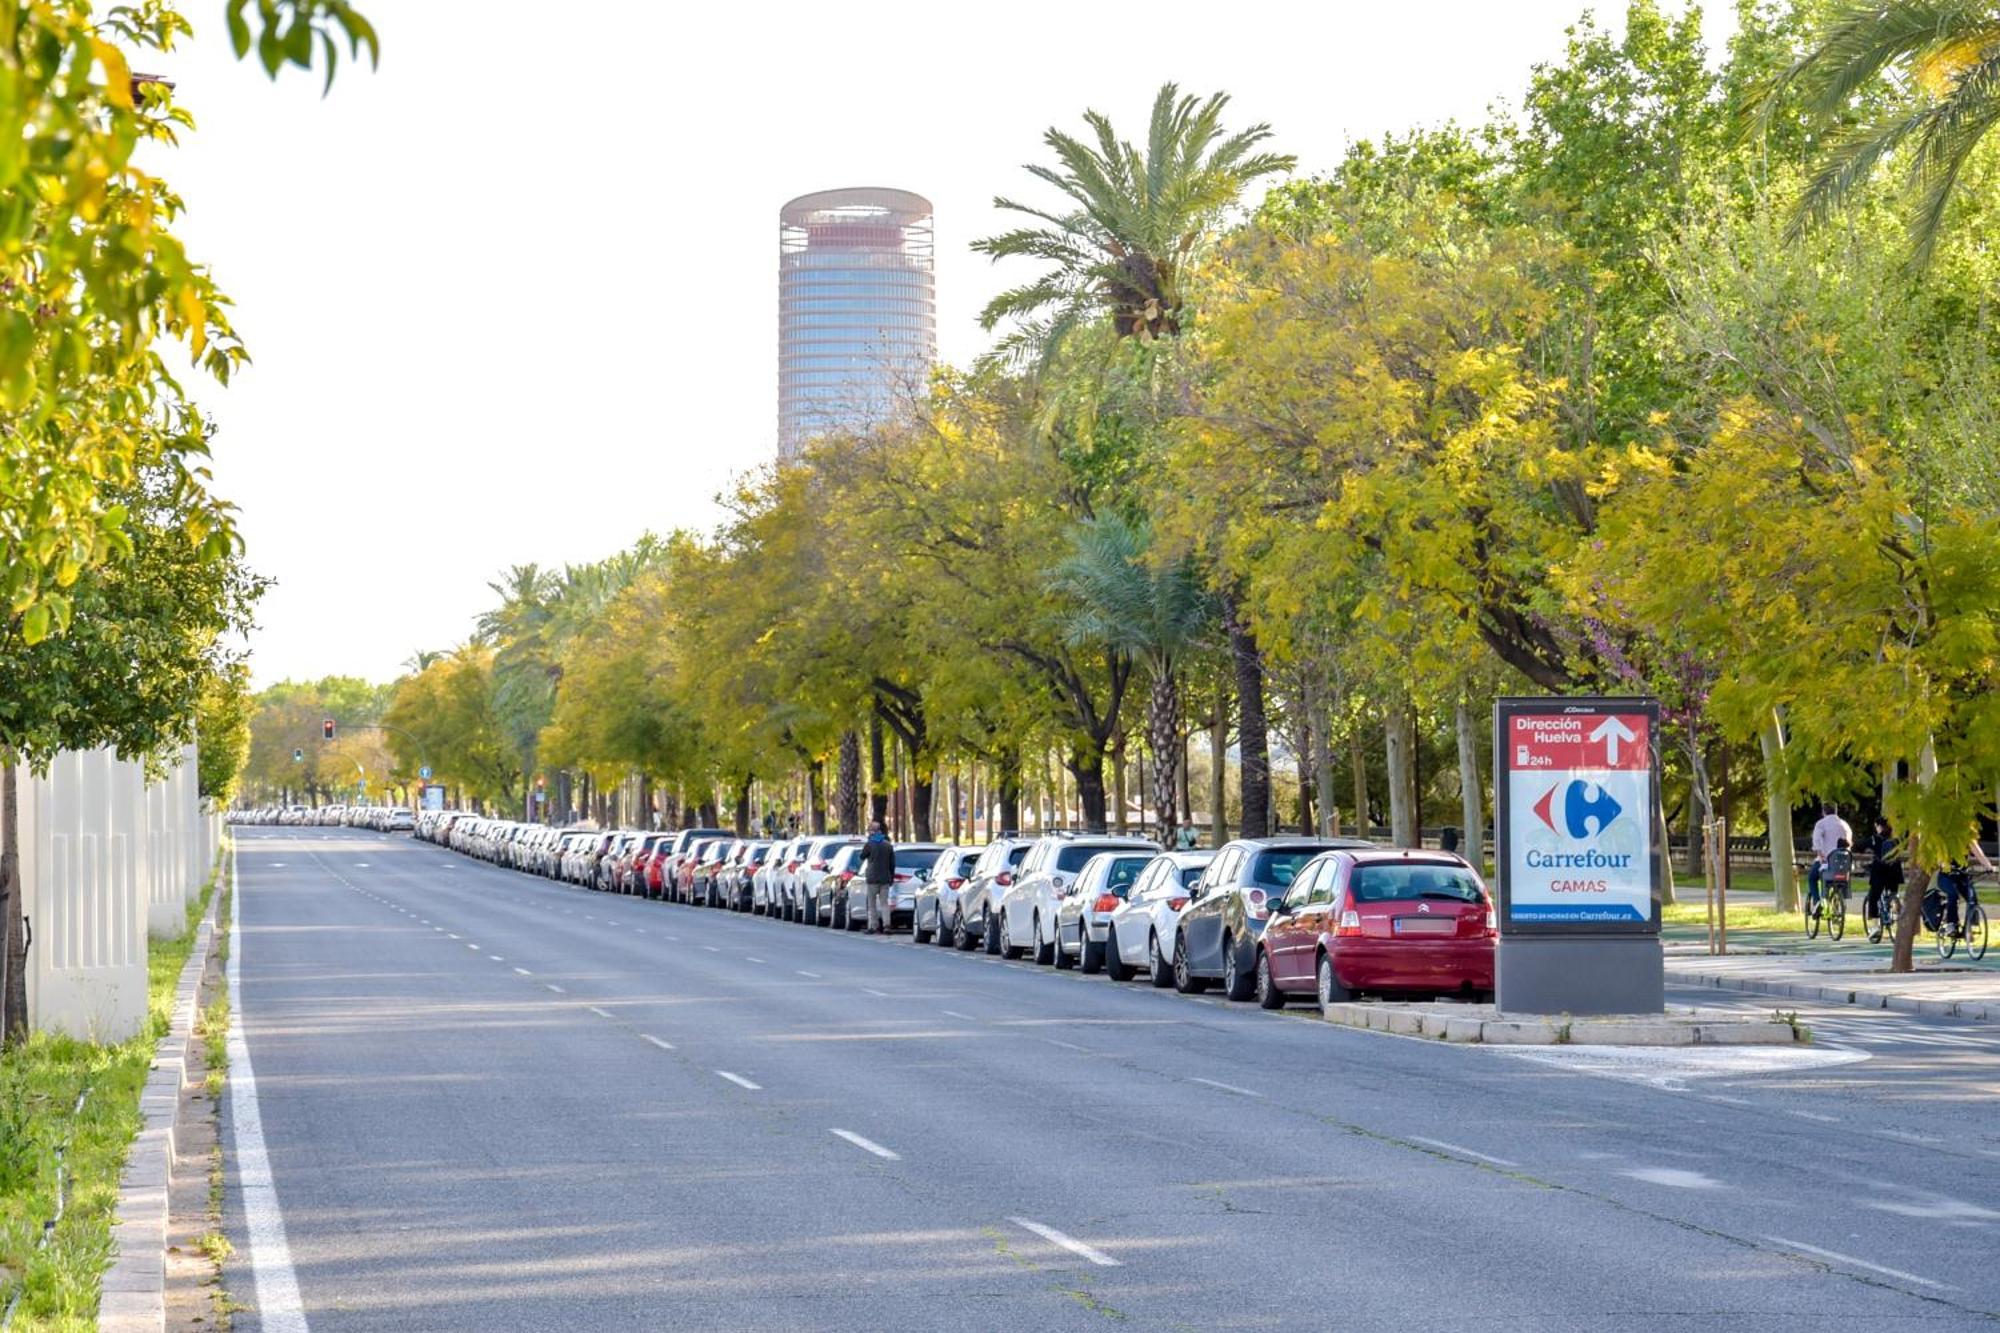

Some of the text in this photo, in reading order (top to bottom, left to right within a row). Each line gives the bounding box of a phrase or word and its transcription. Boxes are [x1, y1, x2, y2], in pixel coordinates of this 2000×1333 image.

[1516, 717, 1581, 730] Dirección
[1535, 731, 1581, 743] Huelva
[1531, 756, 1552, 766] 24h
[1526, 849, 1631, 868] Carrefour
[1550, 880, 1606, 892] CAMAS
